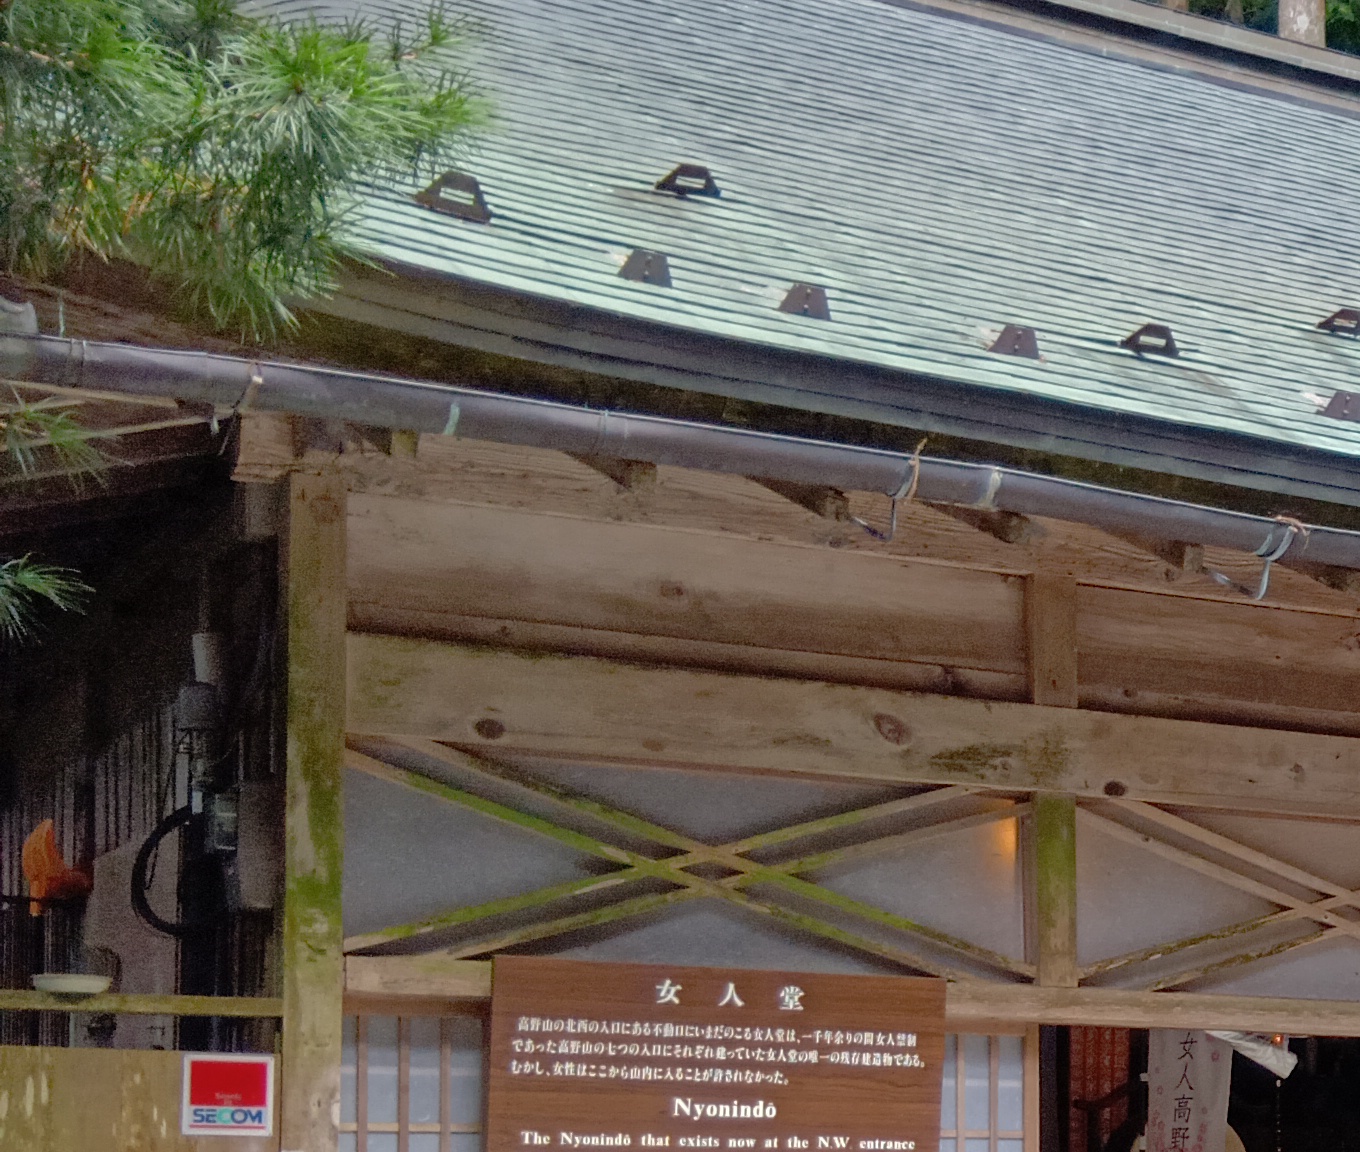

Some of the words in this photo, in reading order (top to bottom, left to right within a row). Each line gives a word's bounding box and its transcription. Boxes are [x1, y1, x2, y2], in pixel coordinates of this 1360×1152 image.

[655, 978, 805, 1011] 女人堂
[192, 1108, 264, 1125] SECOM
[519, 1129, 551, 1145] The
[640, 1132, 670, 1147] that
[677, 1134, 720, 1148] exists
[728, 1138, 757, 1148] now
[764, 1137, 778, 1149] at
[786, 1135, 809, 1149] the
[858, 1138, 916, 1151] entrance
